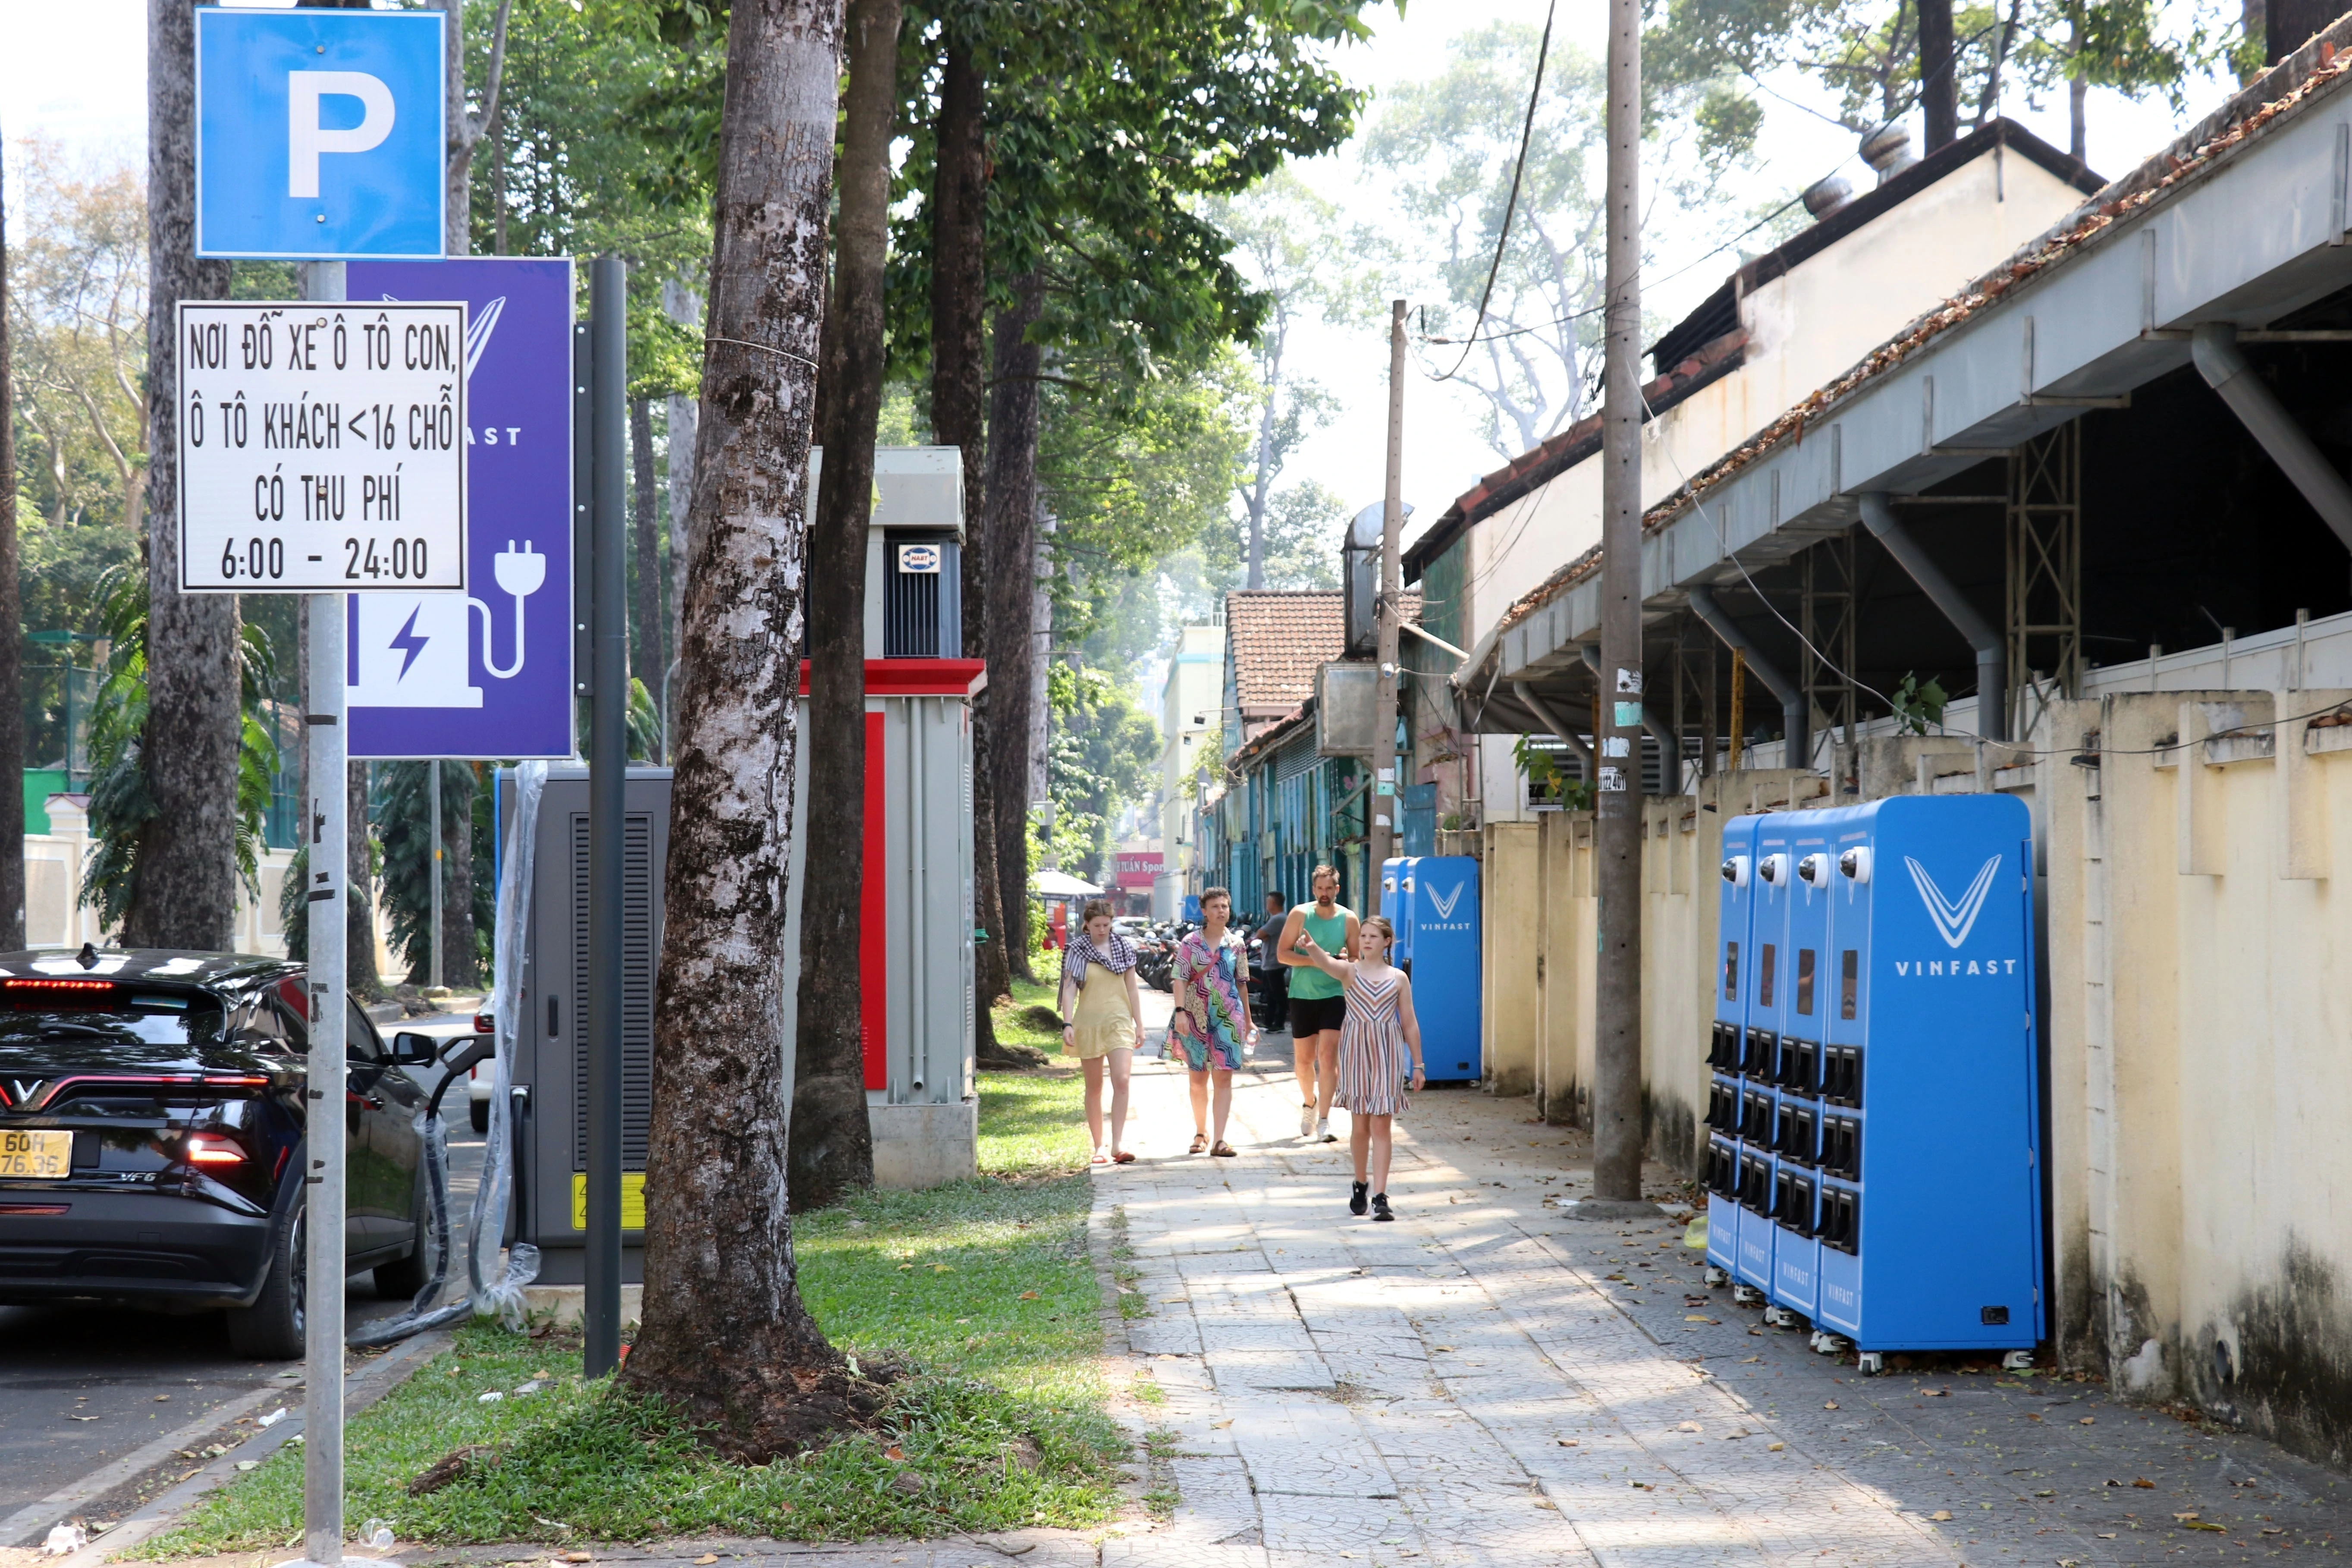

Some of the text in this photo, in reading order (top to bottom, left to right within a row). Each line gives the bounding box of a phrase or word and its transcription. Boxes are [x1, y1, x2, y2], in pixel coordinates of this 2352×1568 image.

[289, 70, 396, 198] P
[191, 310, 456, 375] NƠI ĐỖ XE Ô TÔ CON,
[191, 390, 204, 448] Ô
[220, 390, 247, 449] TÔ
[408, 383, 452, 451] CHỖ
[255, 463, 403, 522] CÓ THU PHÍ
[221, 537, 284, 580] 6:00
[345, 538, 428, 580] 24:00
[1895, 959, 2016, 976] VINFAST
[6, 1133, 45, 1152] 60H
[1783, 1261, 1809, 1287] VINFAST
[1828, 1283, 1853, 1307] VINFAST
